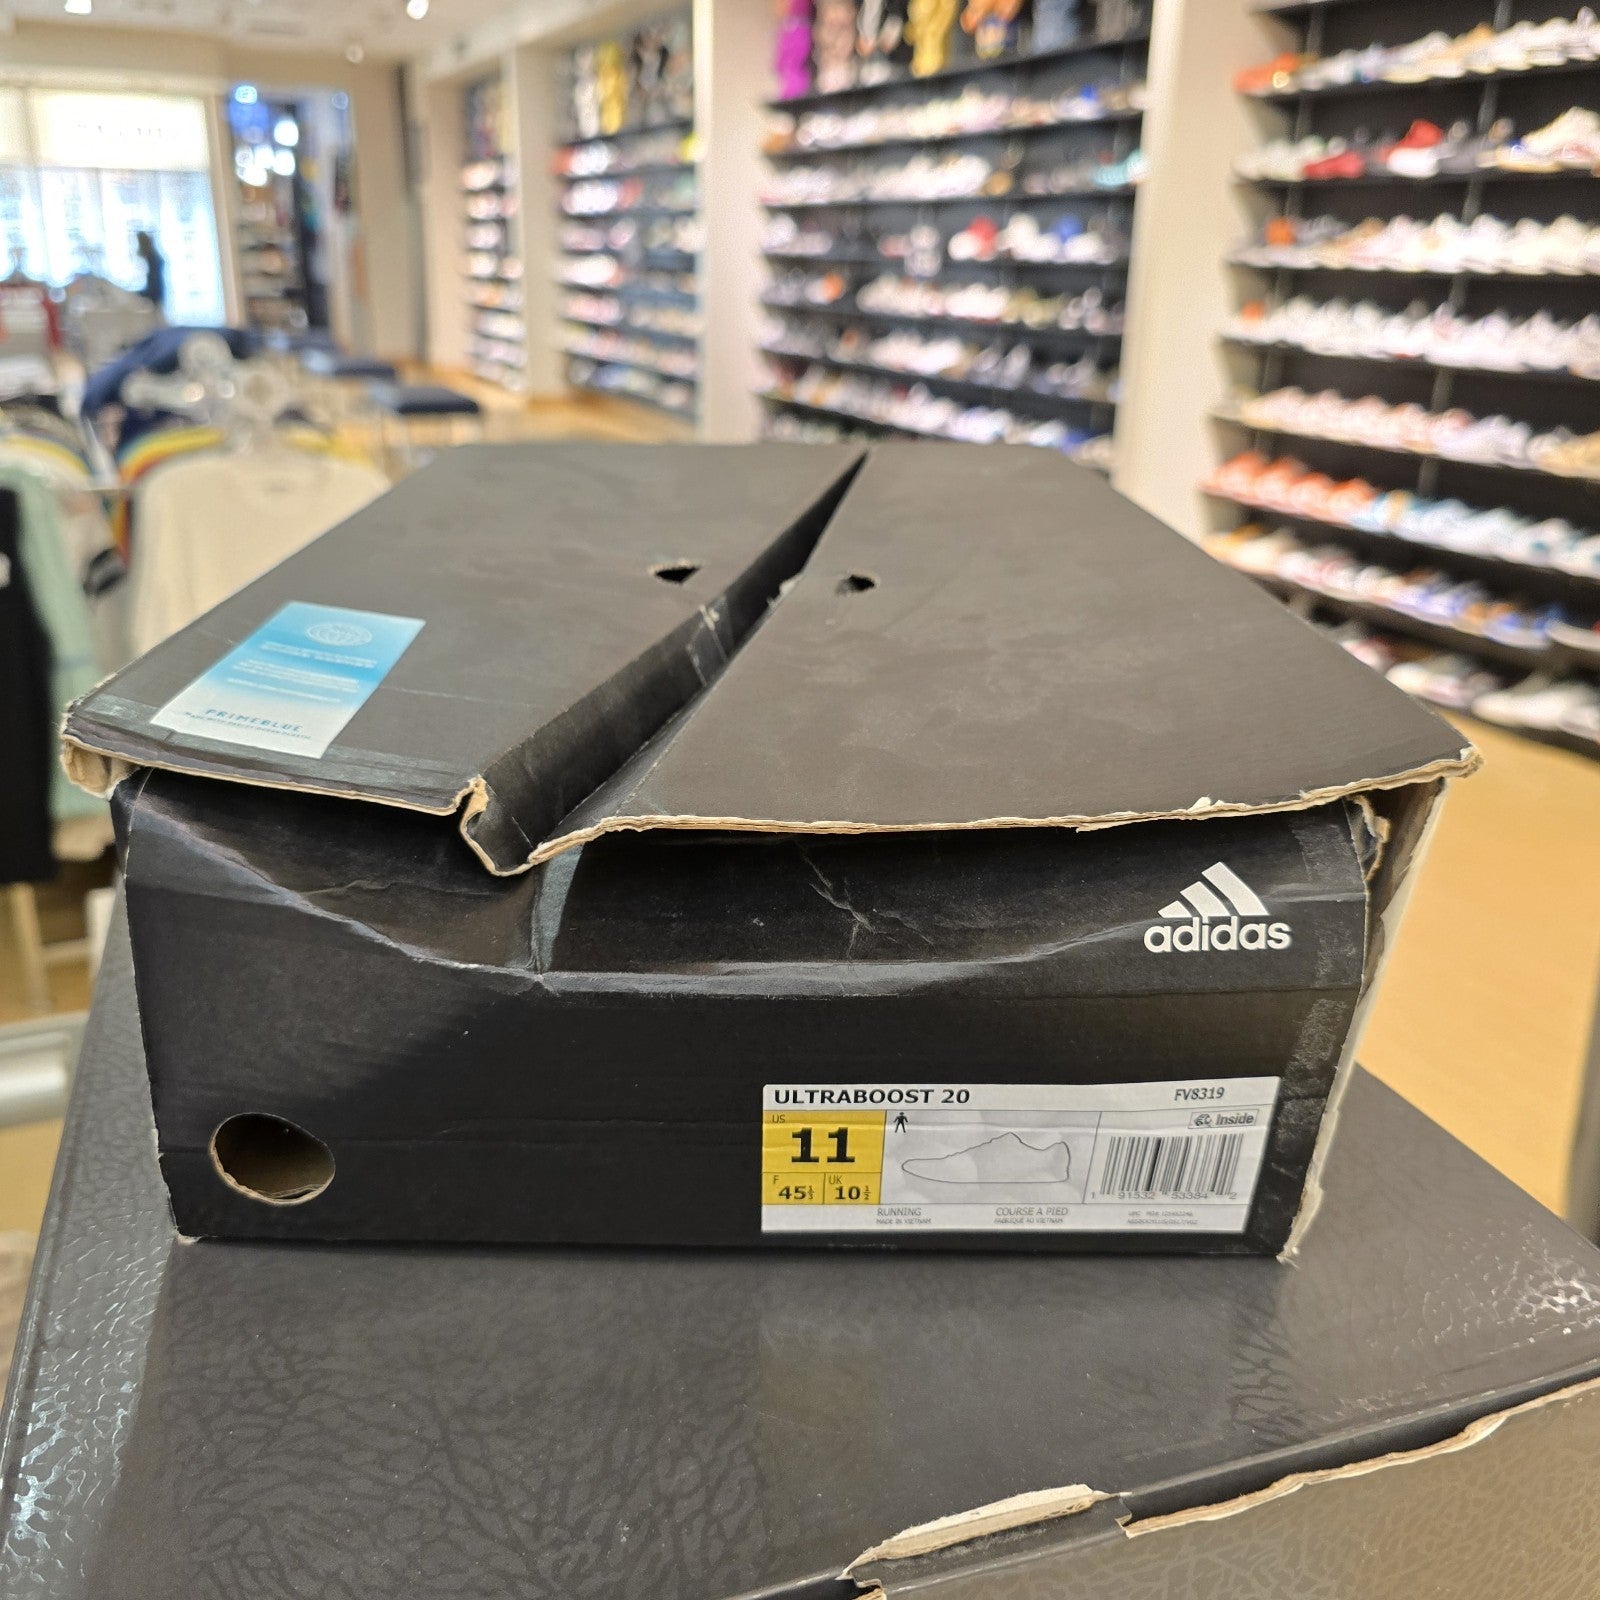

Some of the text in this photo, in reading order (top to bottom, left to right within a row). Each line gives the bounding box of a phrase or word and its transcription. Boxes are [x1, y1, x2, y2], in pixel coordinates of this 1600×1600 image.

[205, 708, 303, 733] PRIMEBLUE
[1143, 915, 1292, 953] adidas
[774, 1088, 970, 1104] ULTRABOOST 20
[1174, 1086, 1225, 1101] FV8319
[772, 1114, 786, 1124] US
[1215, 1112, 1254, 1126] Inside
[791, 1126, 856, 1163] 11
[773, 1175, 779, 1184] F
[828, 1175, 842, 1185] UK
[1228, 1191, 1238, 1200] 2
[877, 1207, 922, 1216] RUNNING
[995, 1206, 1069, 1216] COURSE A PIED
